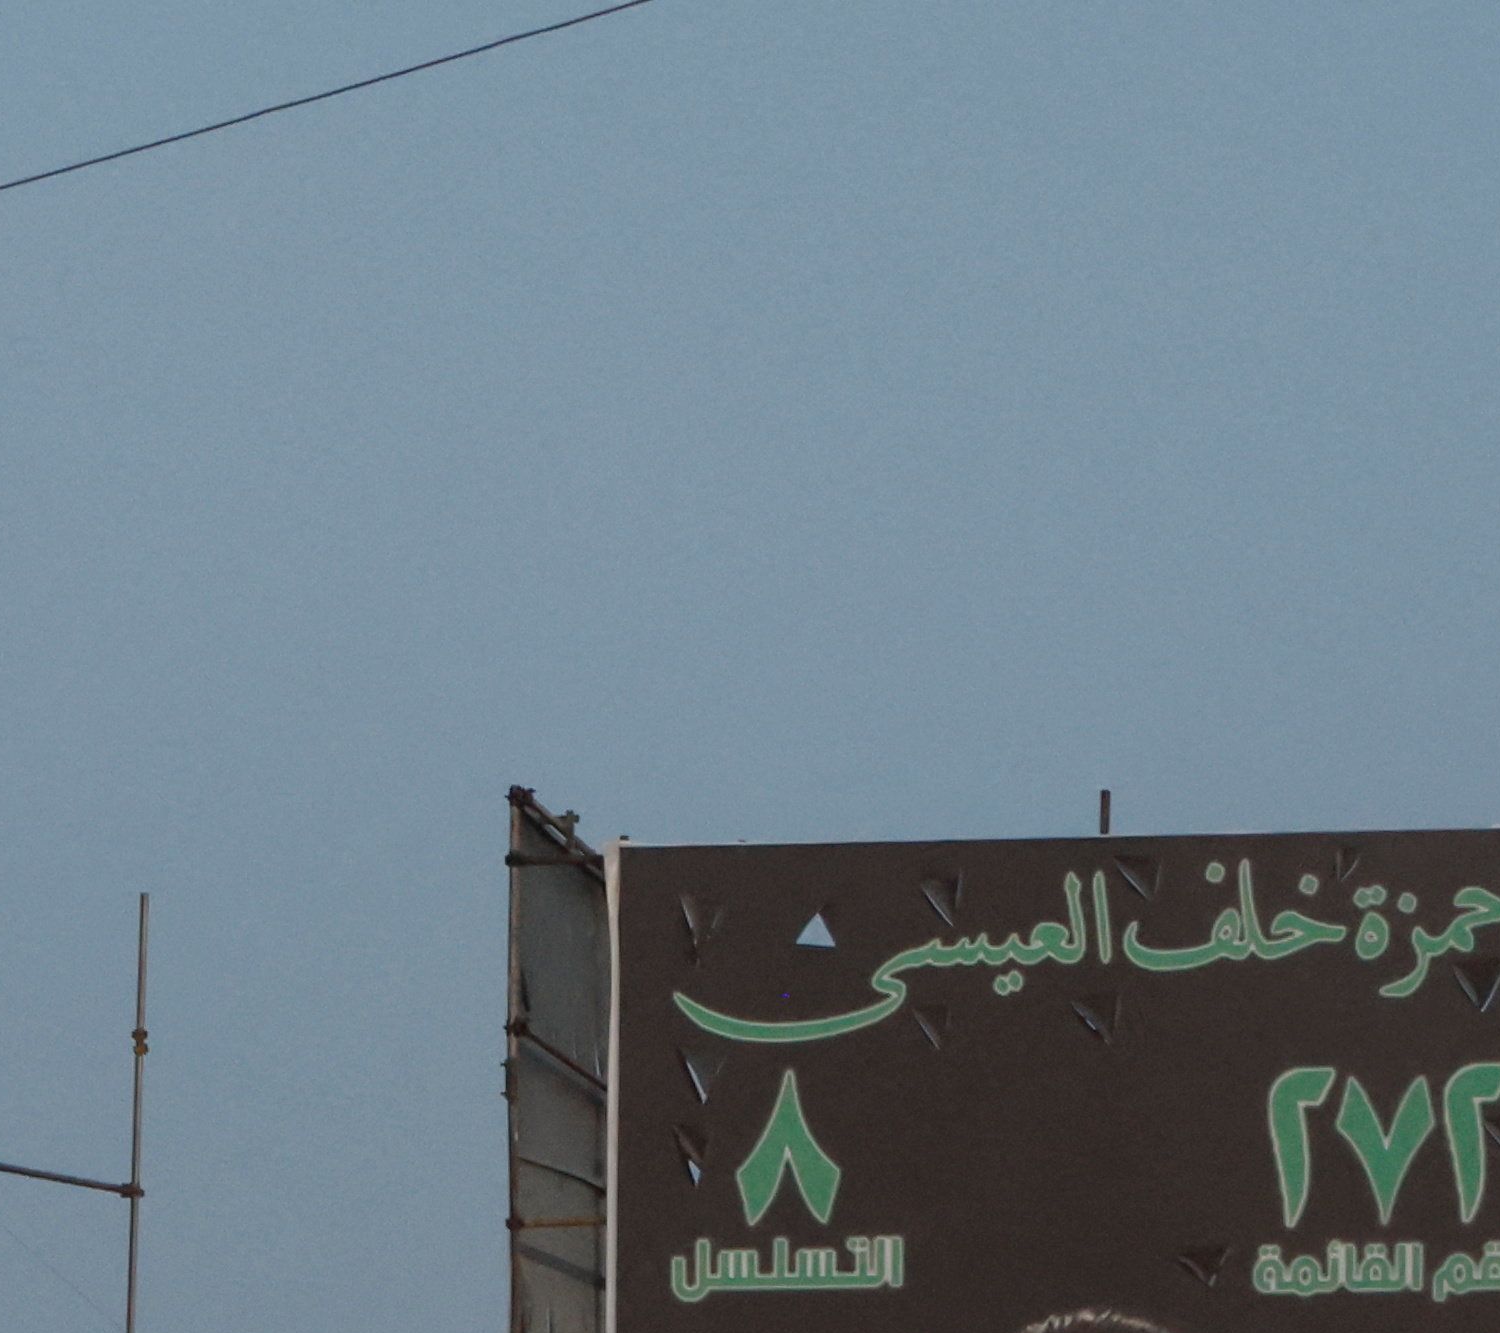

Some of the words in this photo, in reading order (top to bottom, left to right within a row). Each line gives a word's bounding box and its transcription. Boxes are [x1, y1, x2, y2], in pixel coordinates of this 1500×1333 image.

[1123, 858, 1347, 973] خلف
[735, 1068, 843, 1227] ٨
[670, 1234, 904, 1303] التسلسل
[1252, 1240, 1424, 1299] القائمة
